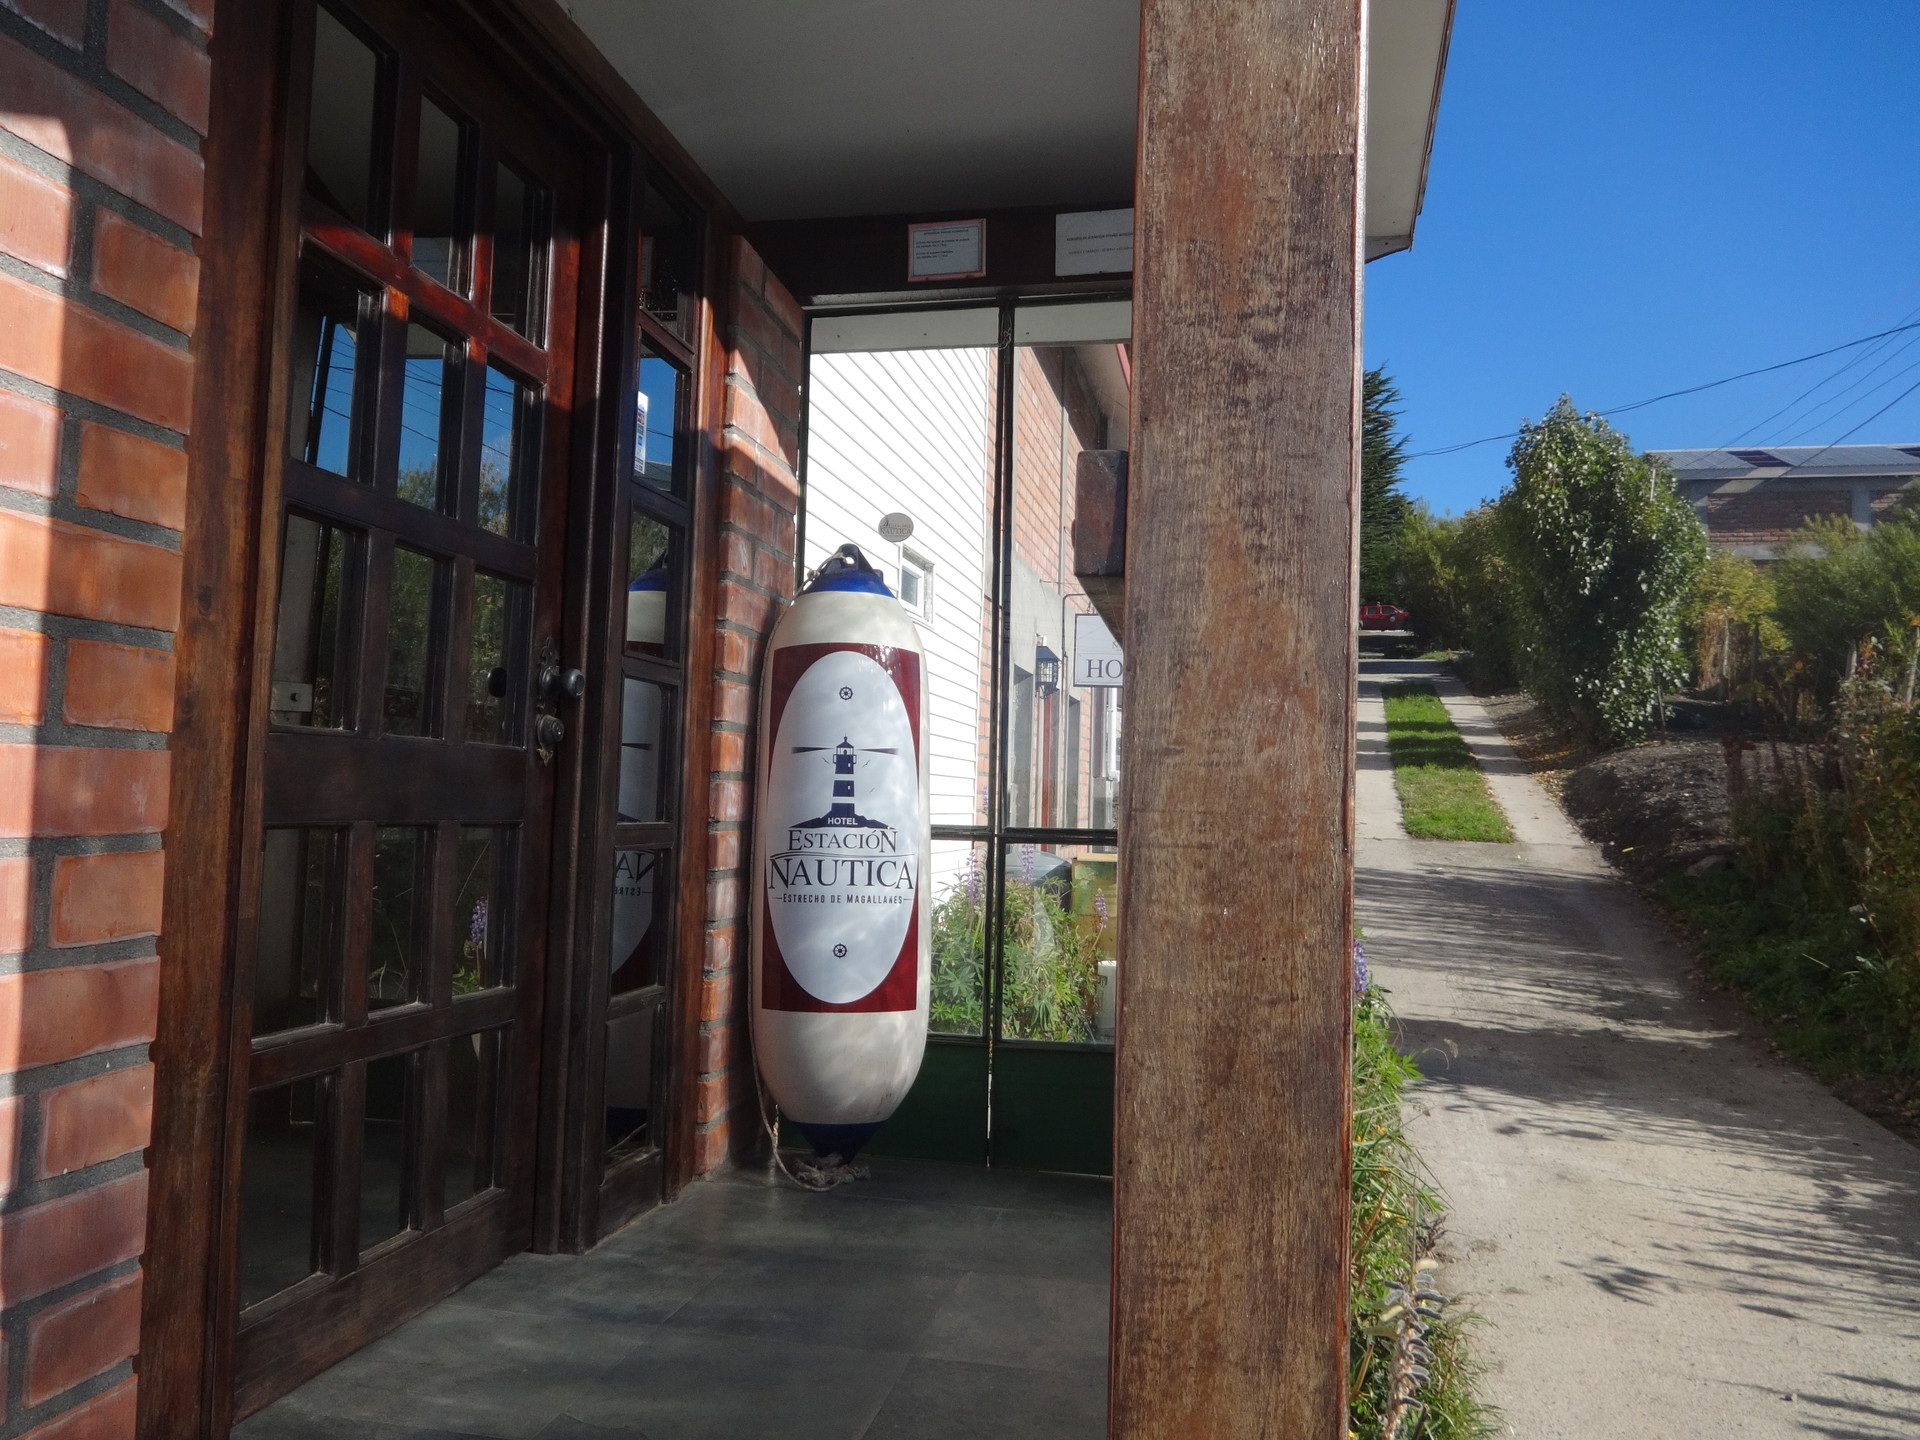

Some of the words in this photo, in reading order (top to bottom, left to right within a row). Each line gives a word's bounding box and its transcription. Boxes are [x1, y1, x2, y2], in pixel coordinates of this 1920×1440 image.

[827, 817, 858, 825] HOTEL
[787, 829, 898, 853] ESTACIÓN
[768, 858, 914, 890] NAUTICA
[783, 893, 825, 903] ESTRECHO
[831, 894, 841, 903] DE
[846, 894, 903, 904] MAGALLANES
